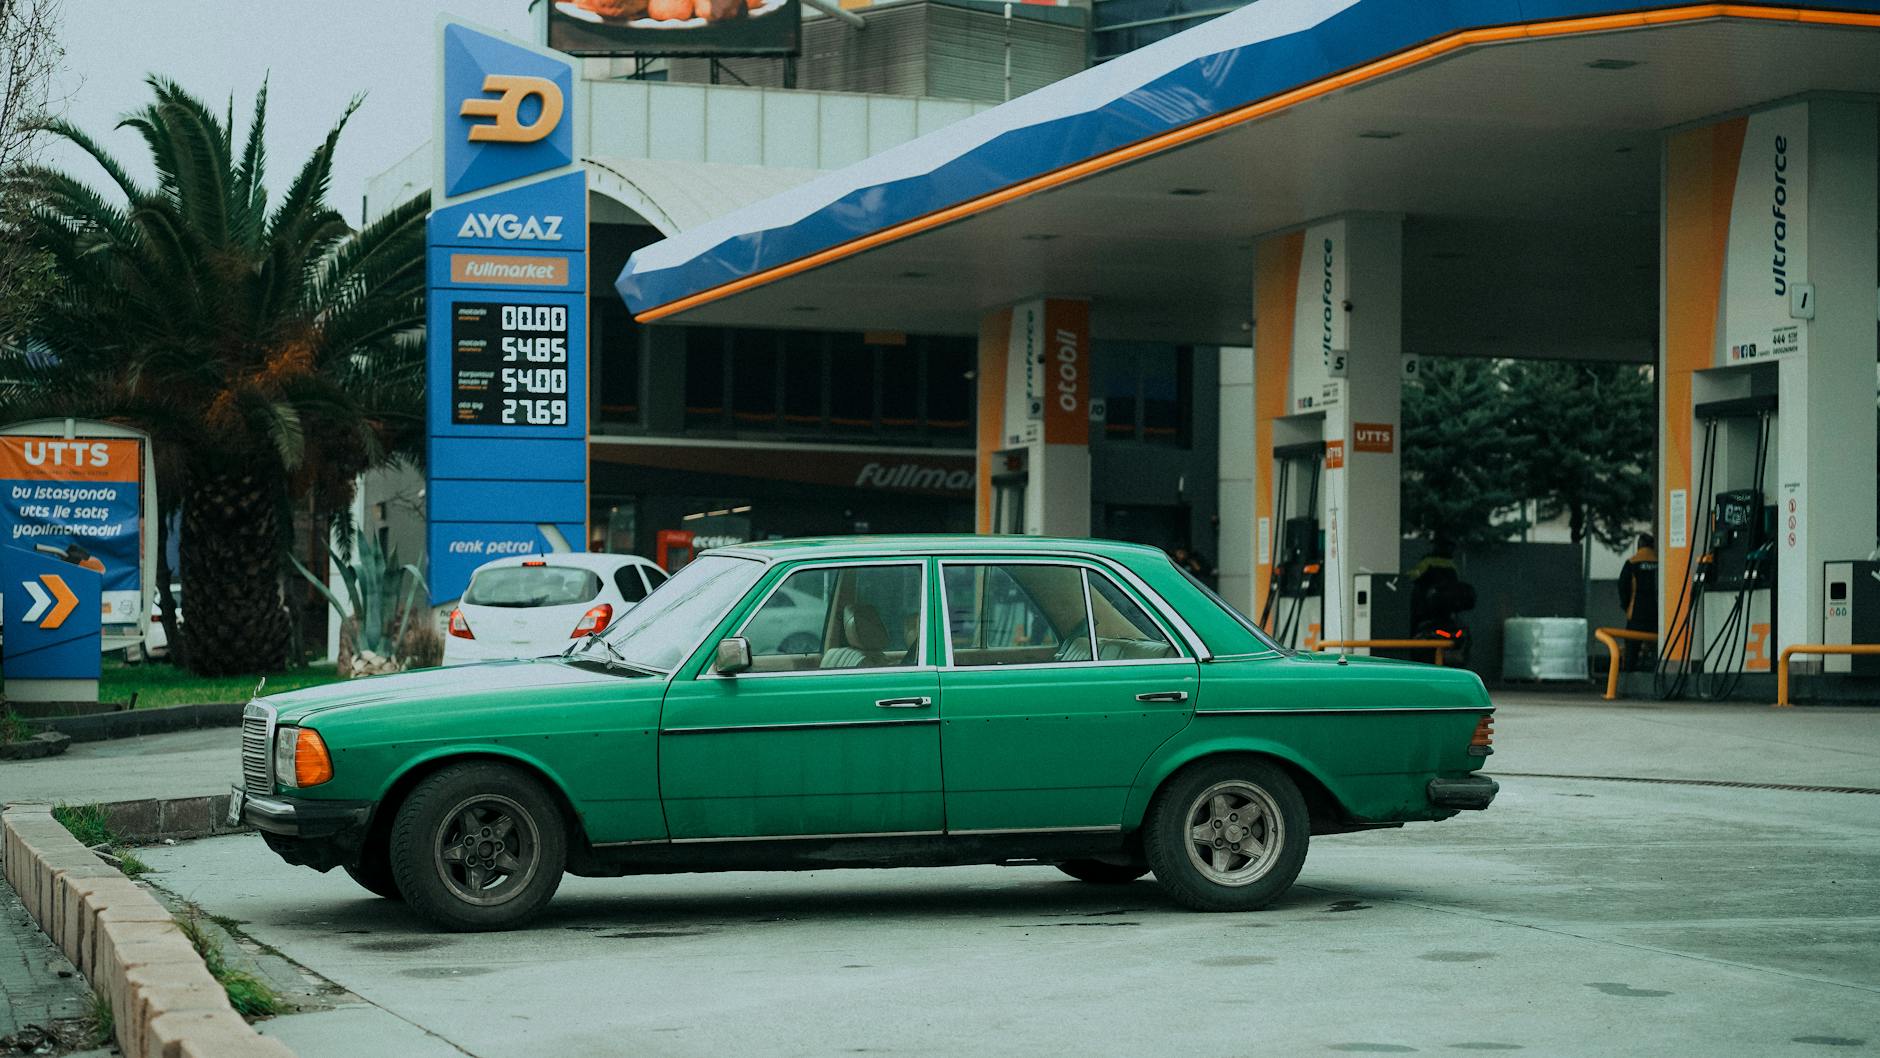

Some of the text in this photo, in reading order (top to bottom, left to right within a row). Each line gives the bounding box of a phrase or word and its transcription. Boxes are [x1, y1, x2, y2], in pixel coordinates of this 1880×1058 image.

[1772, 135, 1787, 296] ultraforce
[457, 212, 563, 240] AYGAZ
[464, 260, 555, 279] fullmarket
[1322, 238, 1333, 366] ltraforce
[1056, 328, 1077, 411] otobil
[1335, 357, 1344, 370] 5
[1406, 359, 1415, 373] 6
[1031, 402, 1040, 414] 9
[1357, 429, 1391, 442] UTTS
[24, 441, 109, 467] UTTS
[12, 486, 117, 503] bu istasyonda
[20, 505, 49, 517] utts
[74, 506, 109, 521] satış
[449, 540, 534, 554] renk petrol
